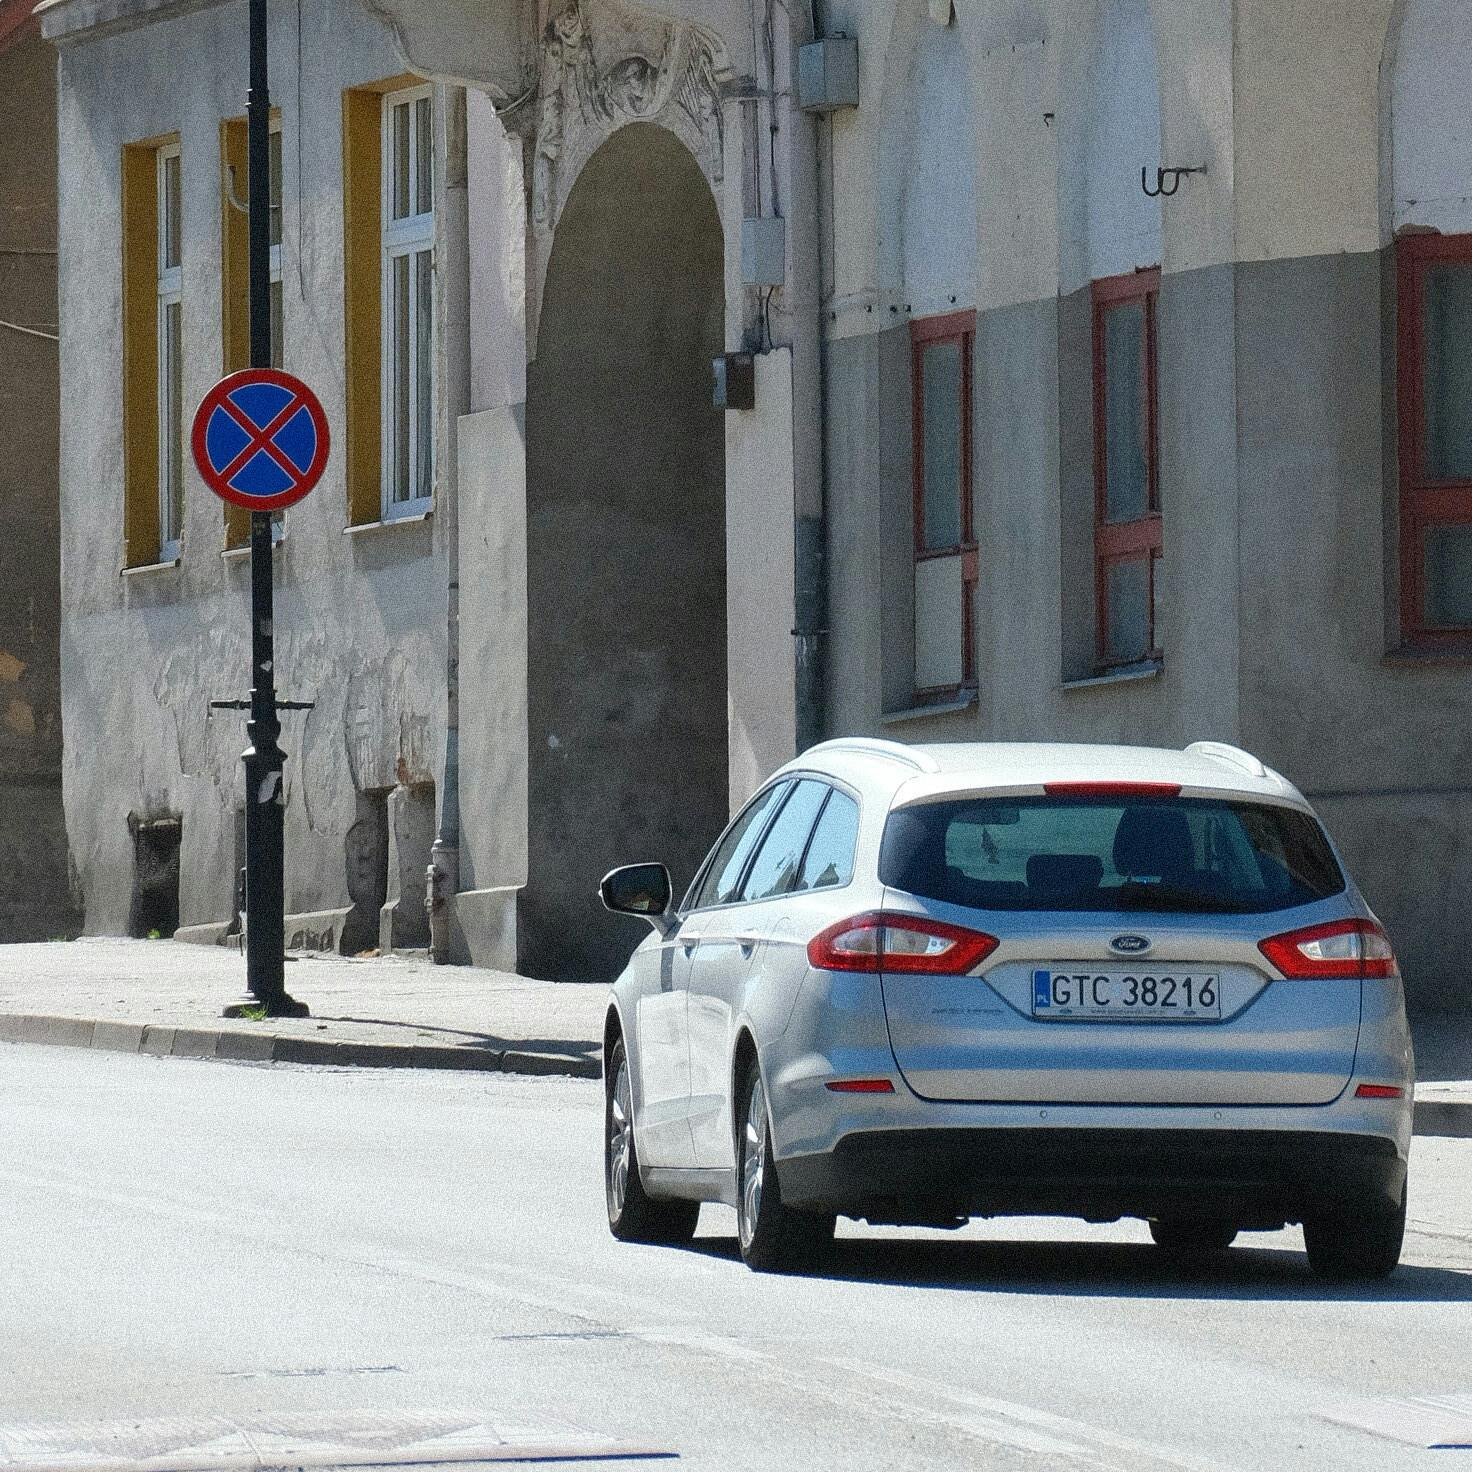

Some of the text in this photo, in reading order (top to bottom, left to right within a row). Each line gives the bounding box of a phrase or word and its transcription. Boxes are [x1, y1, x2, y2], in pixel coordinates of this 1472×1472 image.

[1036, 994, 1049, 1004] PL
[1052, 975, 1216, 1007] GTC 38216
